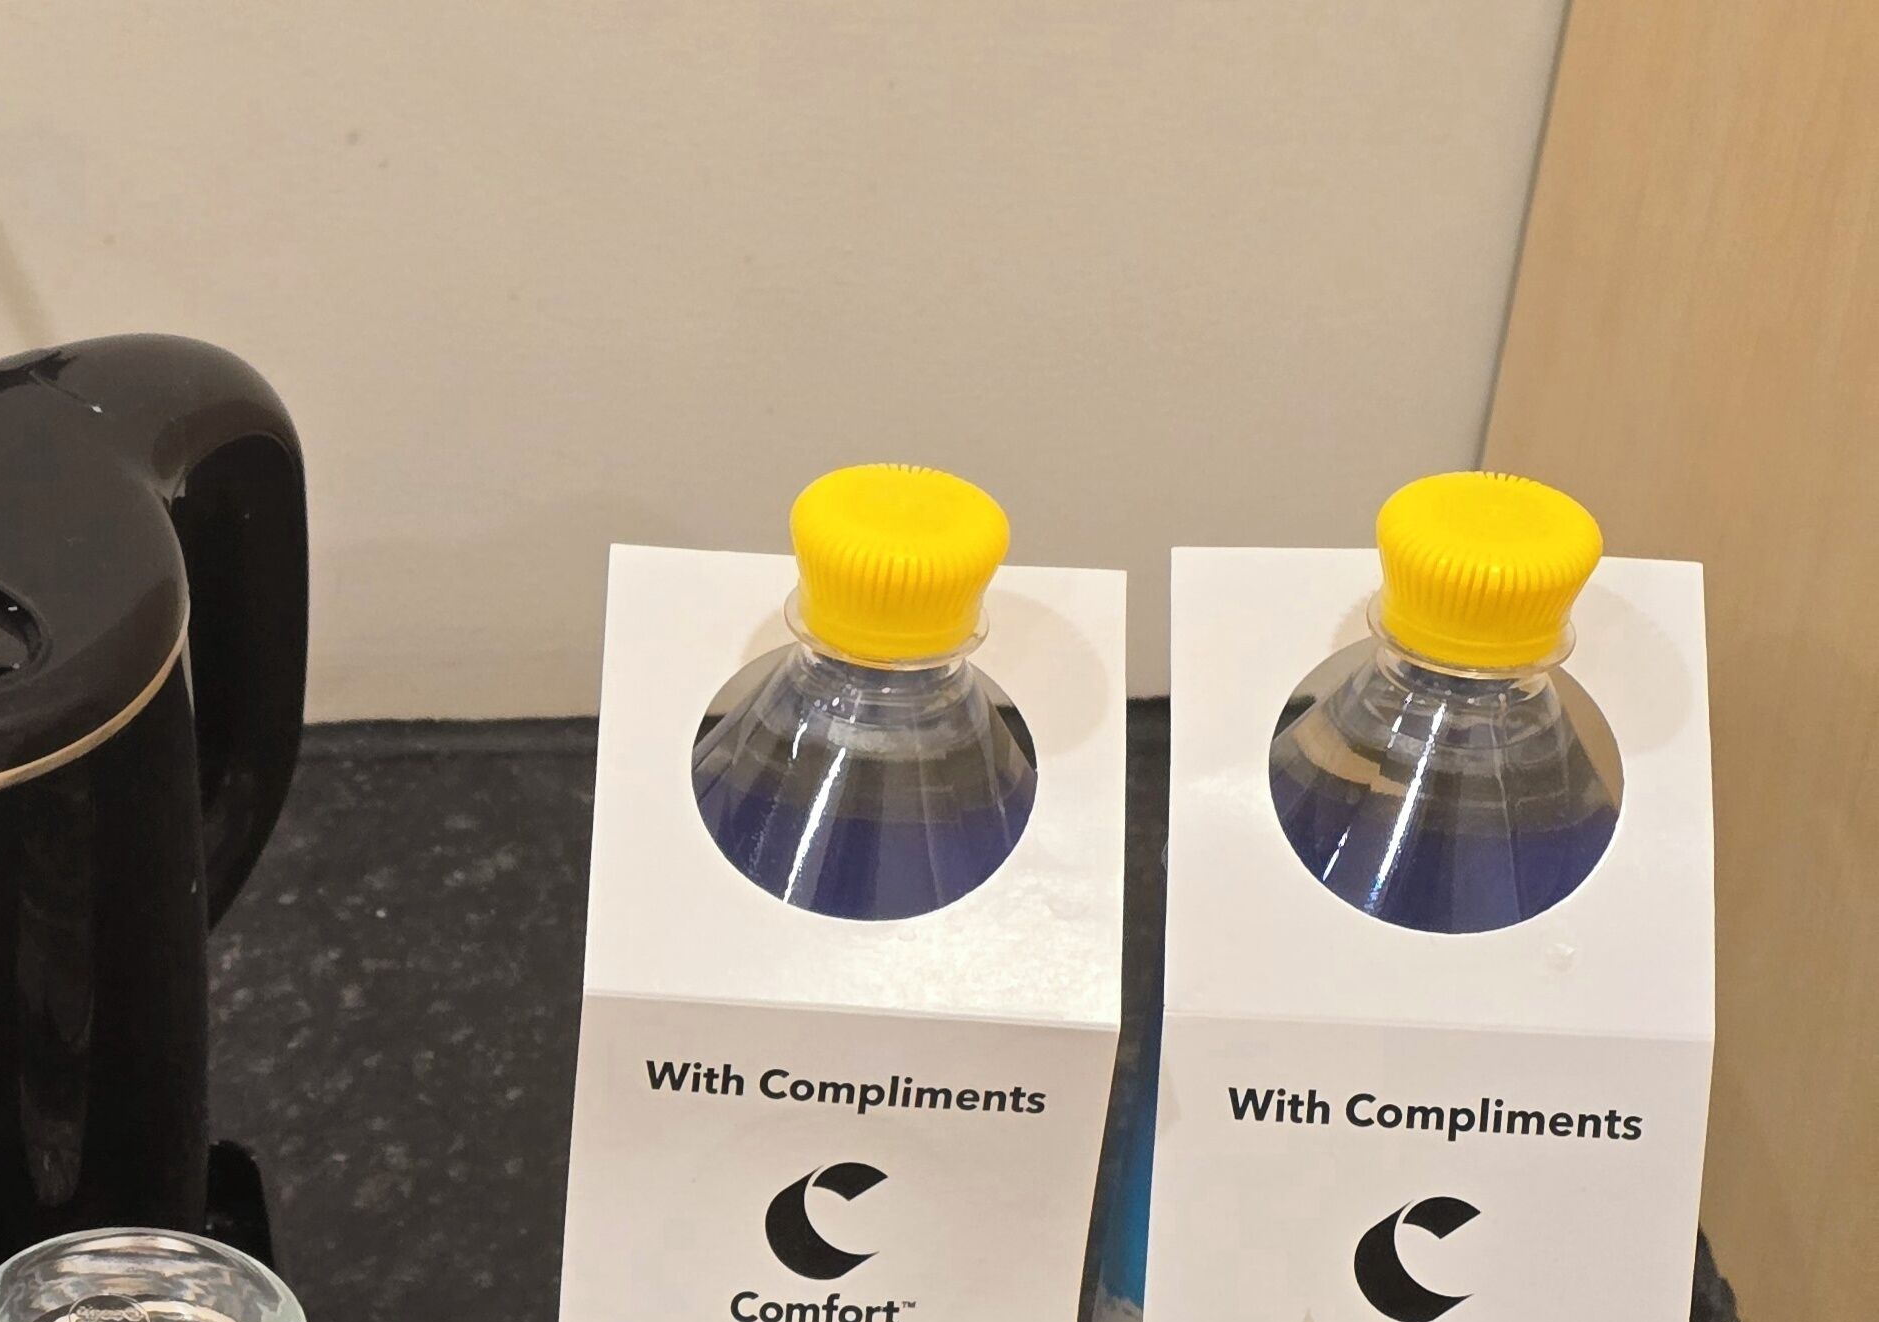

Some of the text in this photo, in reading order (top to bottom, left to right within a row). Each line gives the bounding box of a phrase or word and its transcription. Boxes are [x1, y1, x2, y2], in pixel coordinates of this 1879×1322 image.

[646, 1060, 1046, 1115] With Compliments
[1228, 1086, 1643, 1141] With Compliments
